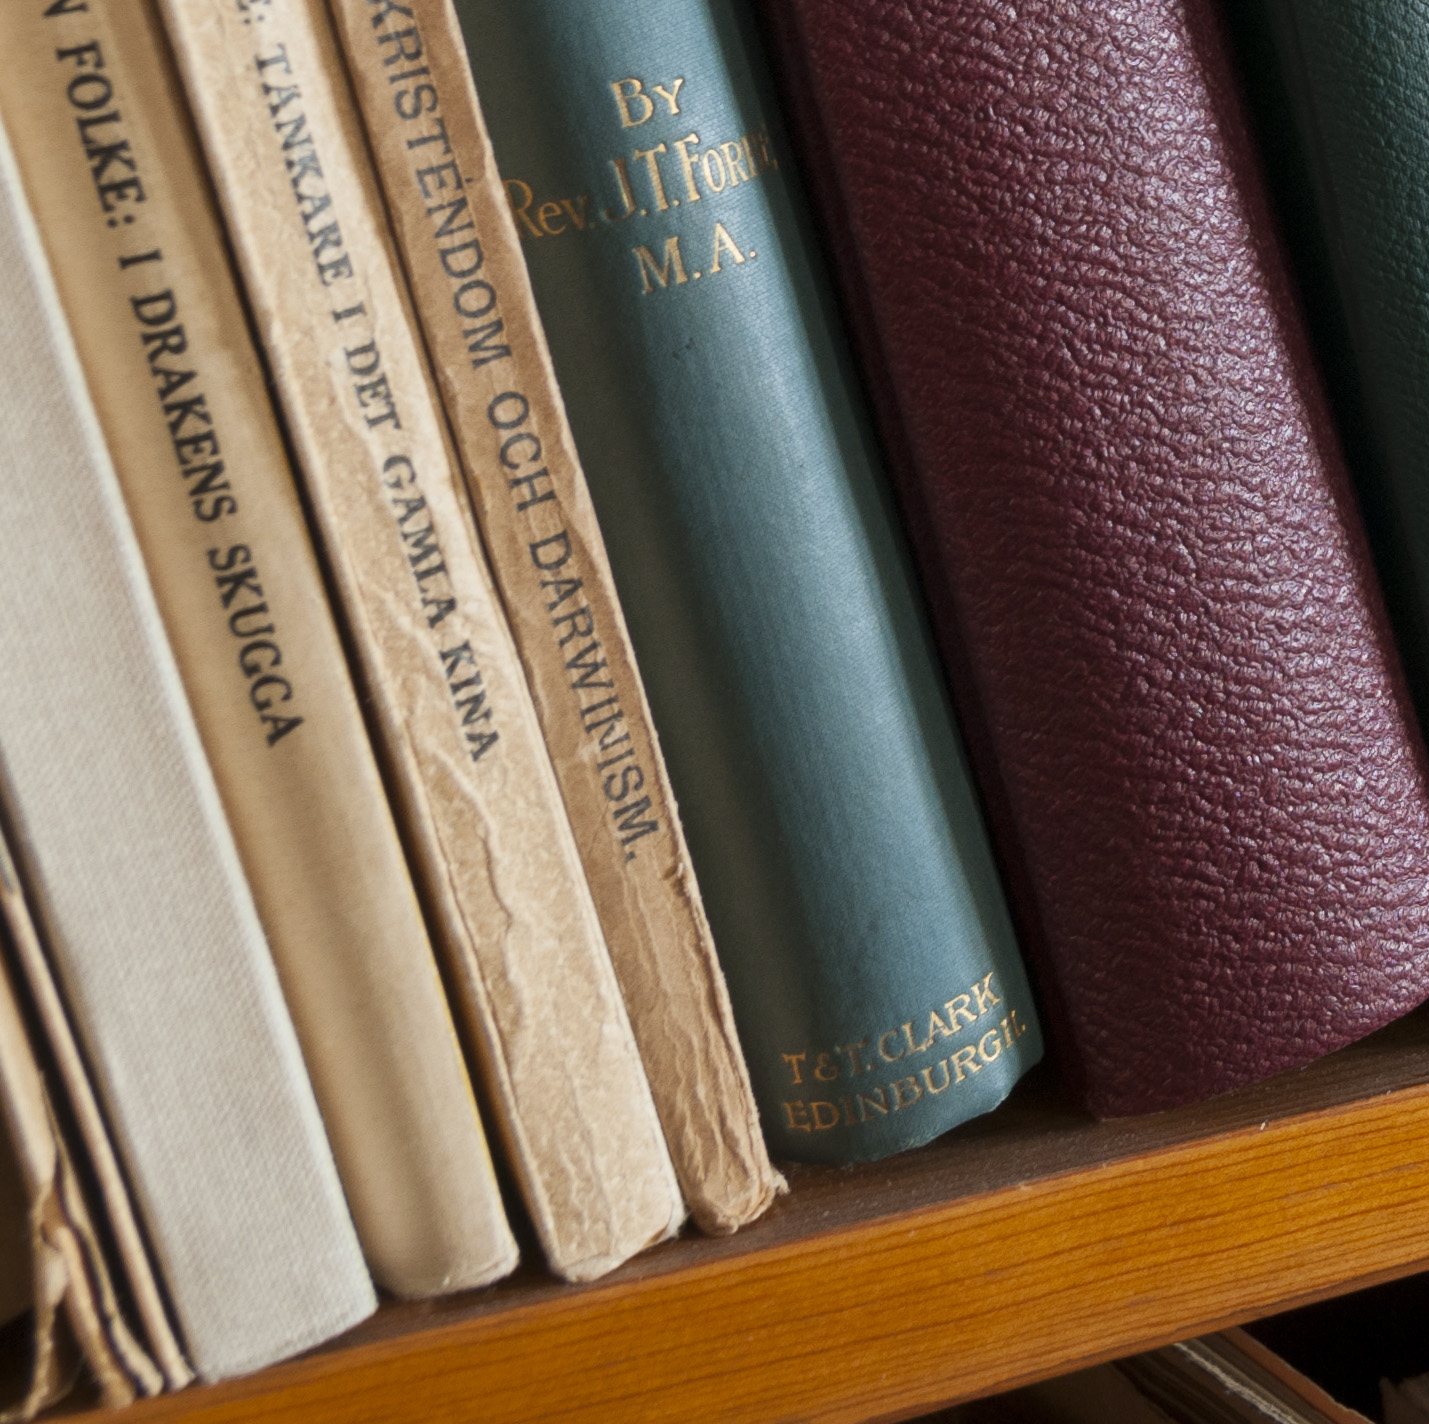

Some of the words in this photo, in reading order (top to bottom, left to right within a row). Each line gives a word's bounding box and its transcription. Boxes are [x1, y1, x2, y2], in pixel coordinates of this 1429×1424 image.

[55, 39, 148, 229] FOLKE:
[254, 41, 355, 289] TÄNKARE
[502, 178, 597, 240] Rev.
[118, 247, 164, 271] I
[332, 301, 367, 322] I
[130, 289, 240, 525] DRAKENS
[343, 339, 403, 432] DET
[381, 453, 459, 630] GAMLA
[207, 543, 306, 749] SKUGGA
[439, 638, 502, 764] KINA
[486, 388, 553, 514] OCH
[527, 528, 661, 863] DARWINISM.
[877, 971, 1001, 1063] CLARK
